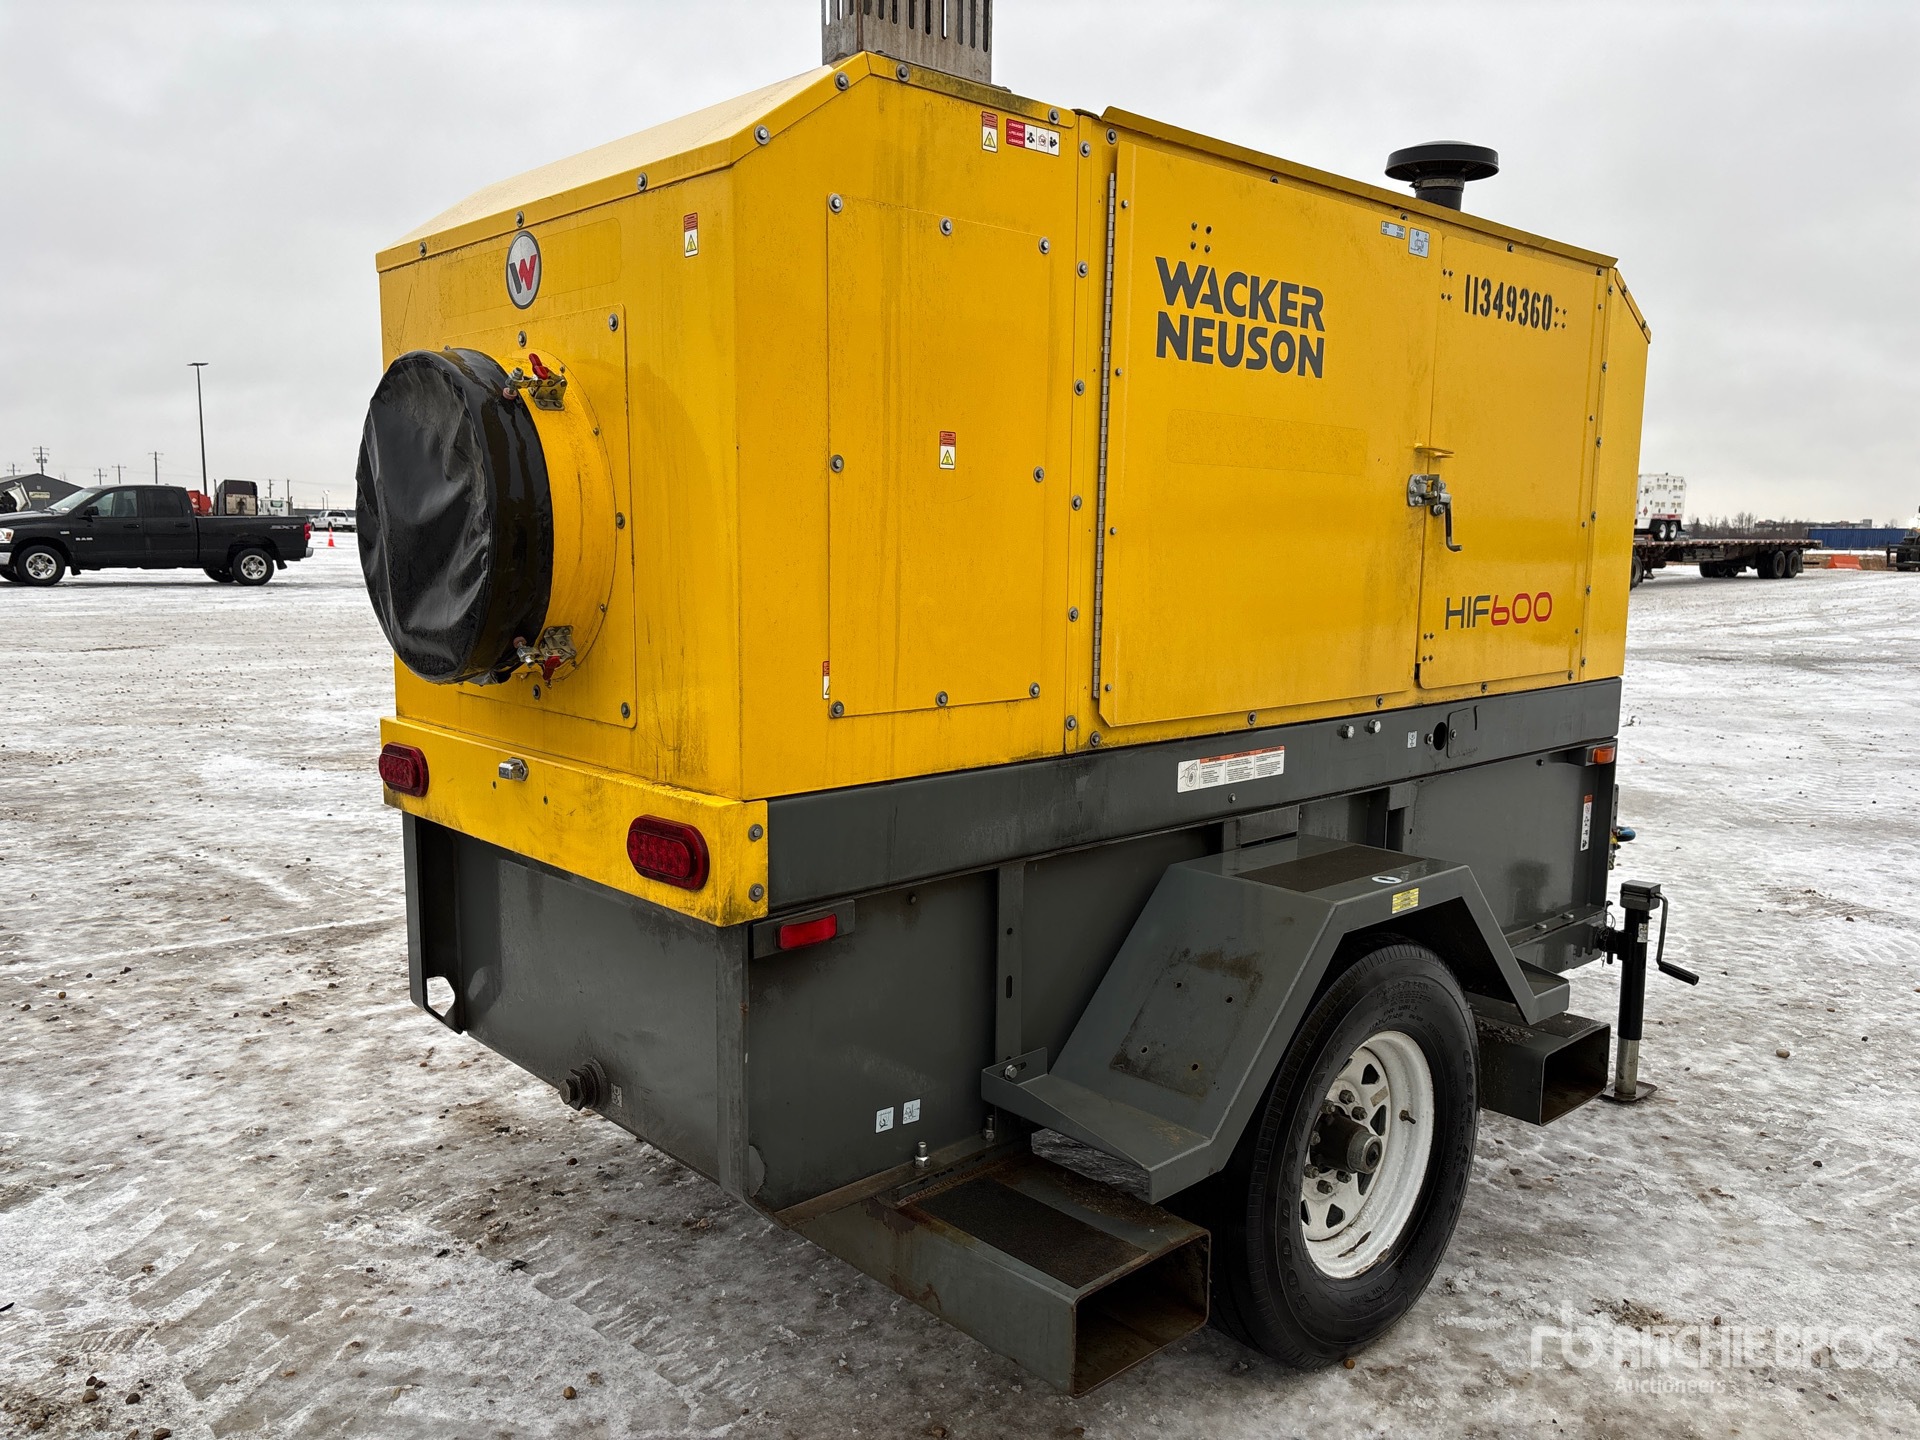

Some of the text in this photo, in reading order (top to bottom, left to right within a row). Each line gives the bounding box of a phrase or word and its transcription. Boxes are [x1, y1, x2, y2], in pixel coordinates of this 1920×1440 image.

[509, 253, 538, 295] W
[1155, 256, 1326, 332] WACKER
[1464, 274, 1553, 331] 11349360
[1156, 310, 1325, 379] NEUSON
[1445, 591, 1553, 630] HIF600
